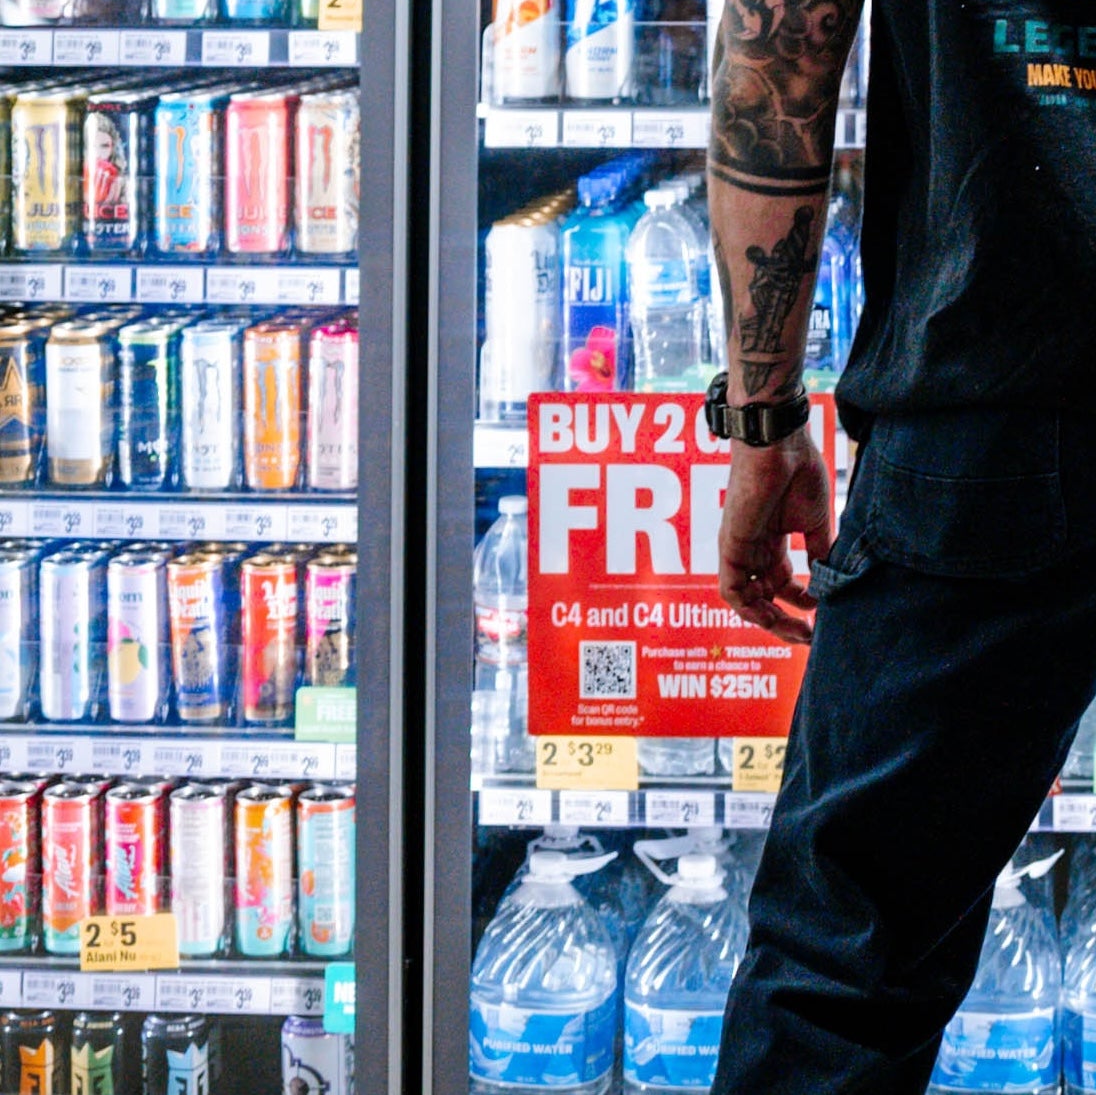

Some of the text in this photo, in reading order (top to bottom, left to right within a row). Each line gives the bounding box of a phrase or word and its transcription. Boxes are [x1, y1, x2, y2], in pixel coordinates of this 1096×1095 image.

[1027, 63, 1072, 88] MAKE
[568, 266, 612, 303] FIJI
[538, 403, 644, 453] BUY
[653, 403, 685, 453] 2
[551, 602, 760, 629] C4 and C4 Ultima
[642, 647, 686, 658] Purchase
[688, 647, 708, 658] with
[674, 661, 683, 670] to
[685, 662, 705, 670] earn
[716, 661, 747, 670] chance
[750, 661, 762, 670] to
[657, 674, 778, 700] WIN $25K!
[571, 716, 585, 726] for
[586, 716, 612, 726] bonus
[578, 705, 638, 716] Scan QR code
[542, 742, 557, 766] 2
[739, 745, 753, 770] 2
[86, 921, 136, 947] 2 $5
[86, 951, 136, 963] Alani Nu
[483, 1038, 573, 1054] PURIFIED WATER
[646, 1042, 696, 1056] PURIFIED
